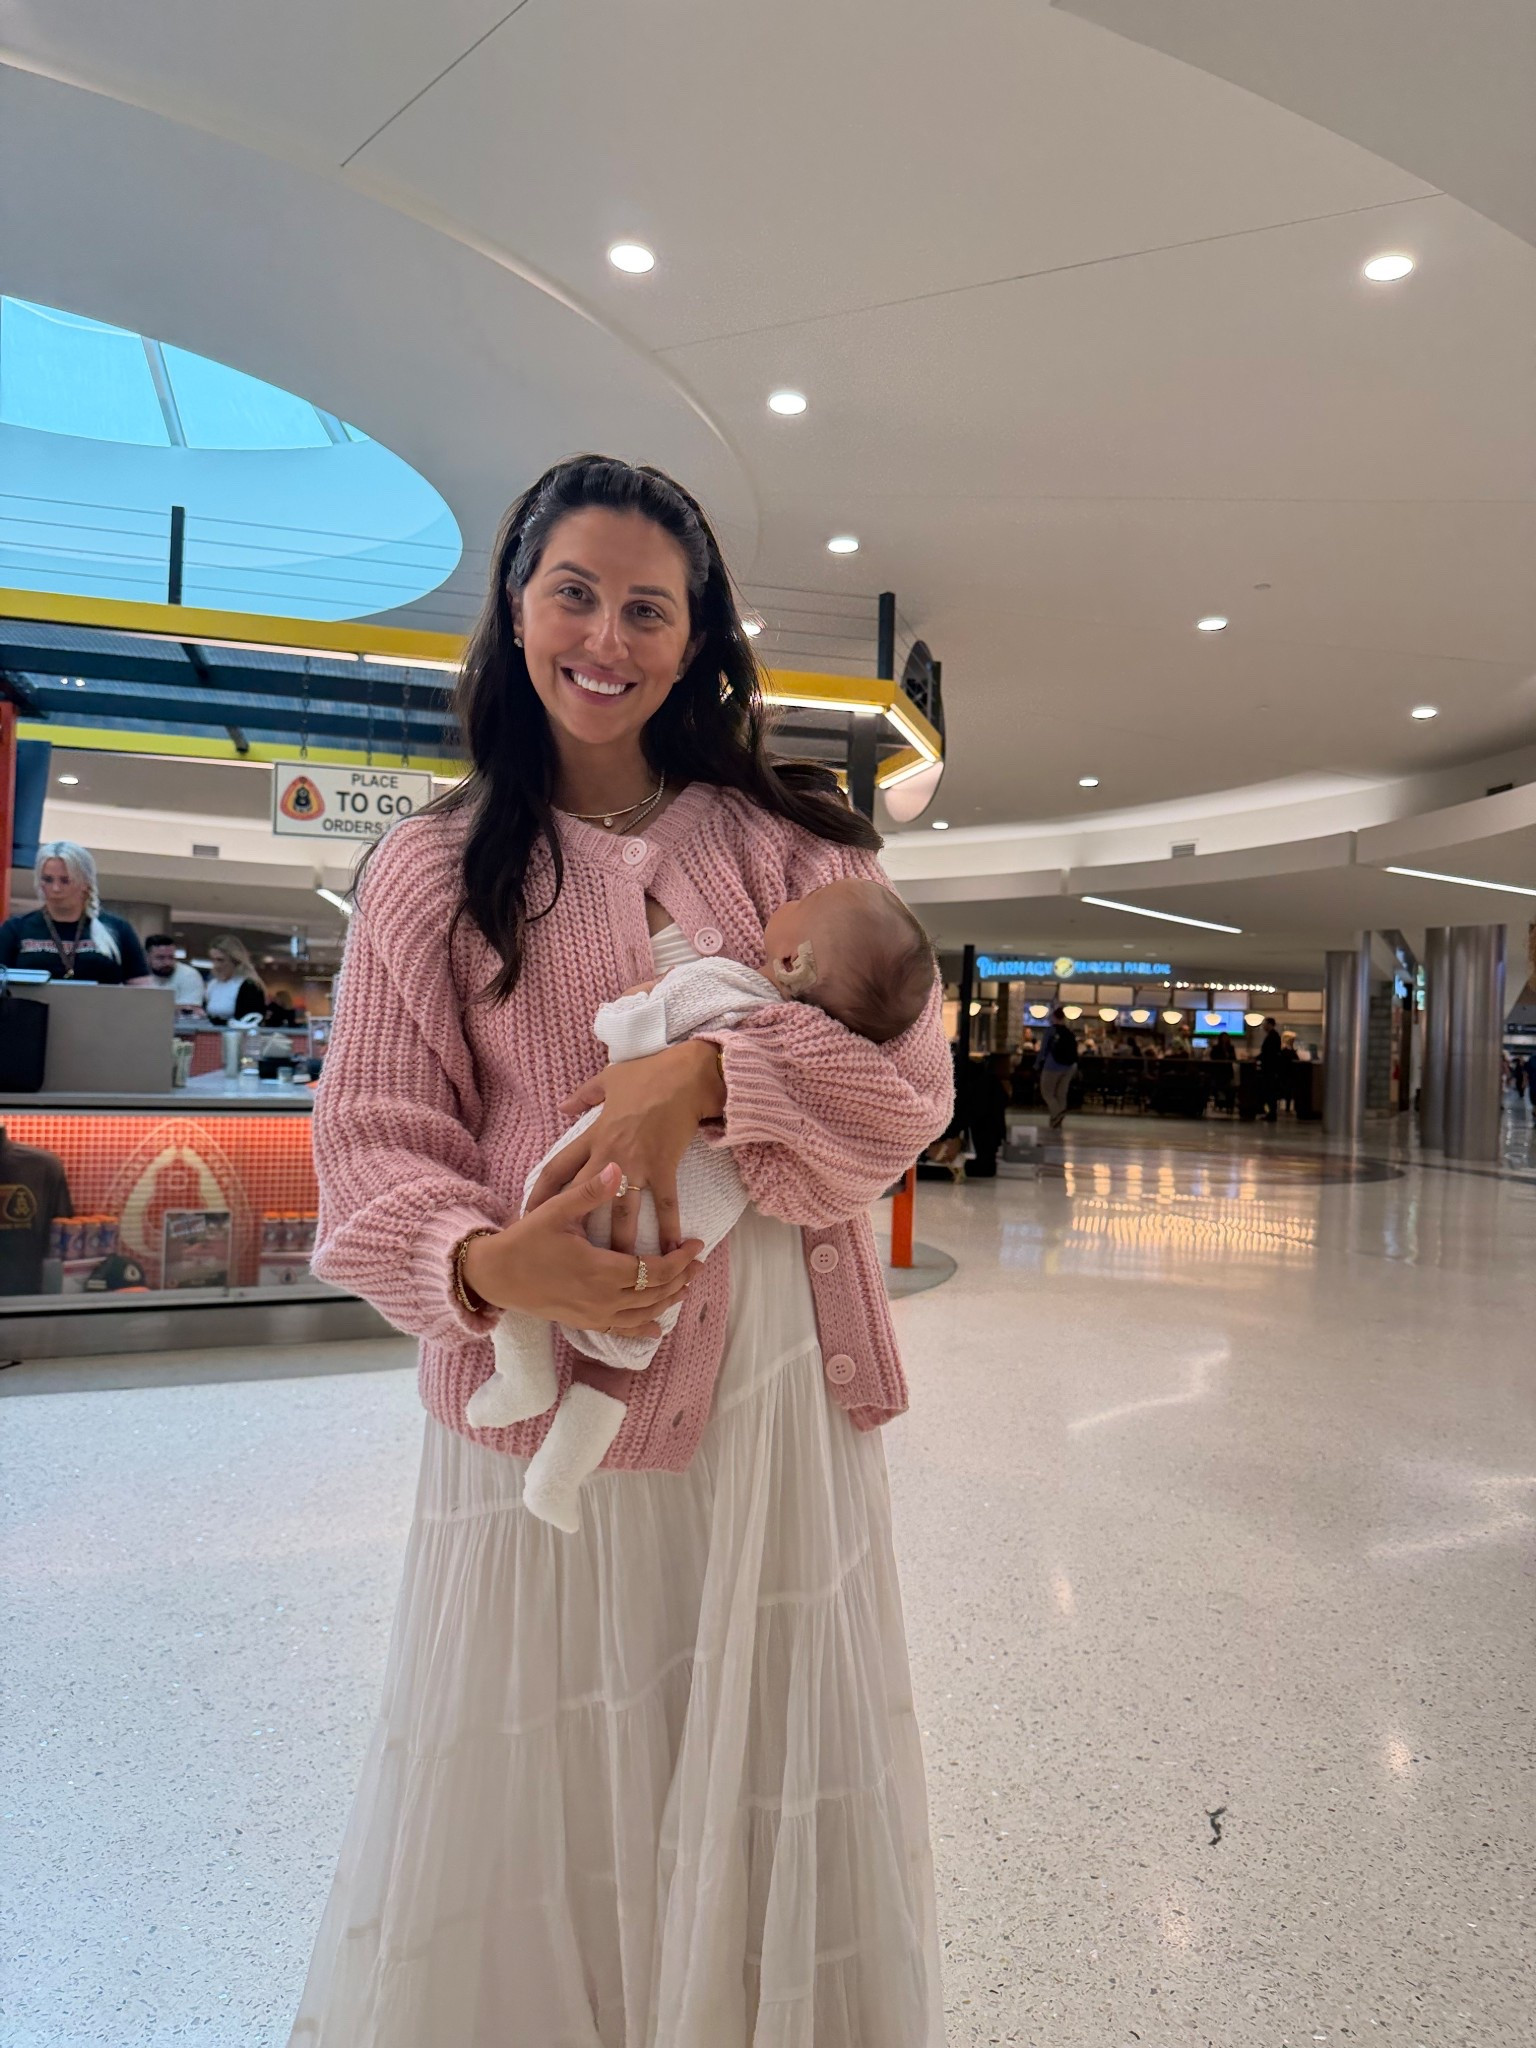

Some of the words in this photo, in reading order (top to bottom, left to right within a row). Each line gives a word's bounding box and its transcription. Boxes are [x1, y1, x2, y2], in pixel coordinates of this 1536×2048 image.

[351, 773, 399, 789] PLACE
[336, 791, 369, 814] TO
[376, 794, 413, 816] GO
[322, 818, 383, 834] ORDERS
